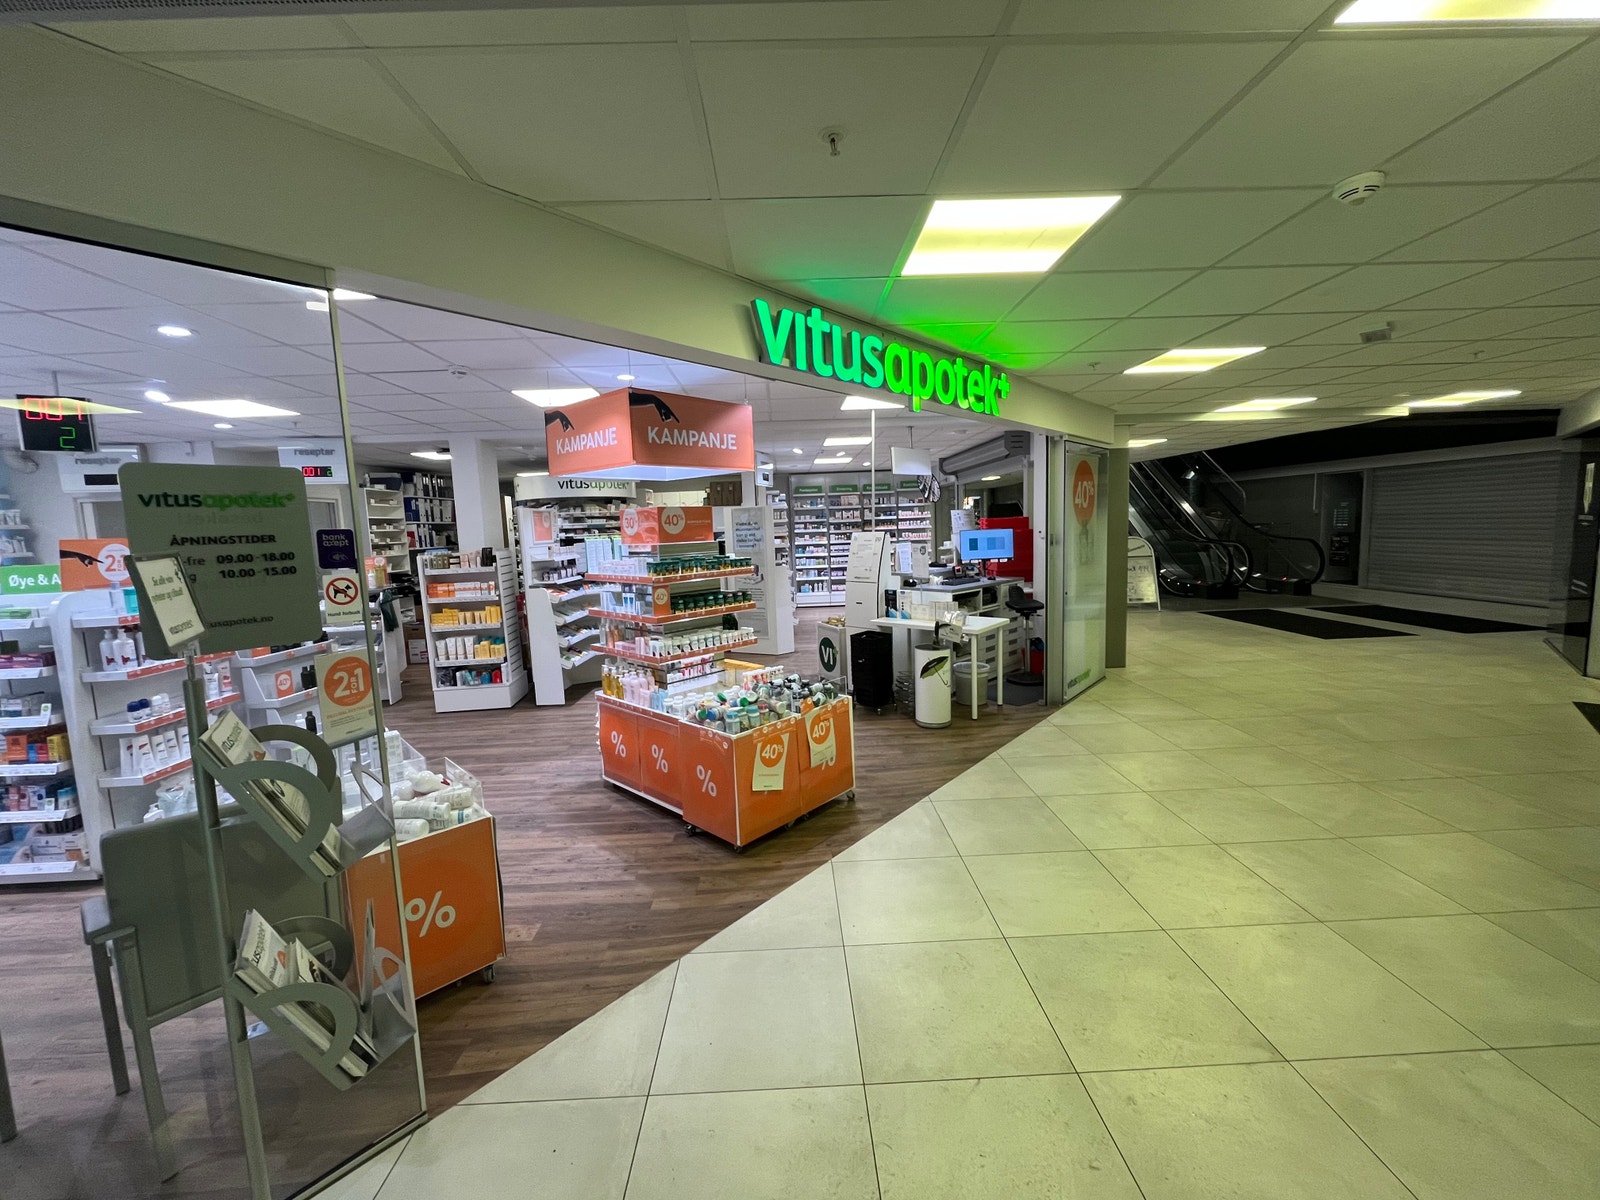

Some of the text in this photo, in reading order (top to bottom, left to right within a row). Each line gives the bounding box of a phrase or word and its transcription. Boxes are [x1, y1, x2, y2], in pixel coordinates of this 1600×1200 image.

[60, 427, 75, 448] 2
[556, 427, 618, 455] KAMPANJE
[647, 426, 737, 450] KAMPANJE
[1074, 482, 1094, 508] 40%
[664, 514, 684, 526] 40%
[170, 534, 276, 547] ÅPNINGSTIDER
[322, 533, 346, 541] bank
[216, 553, 254, 565] 09.00
[261, 552, 295, 562] 18.00
[8, 574, 35, 589] Øye
[37, 573, 49, 585] &
[219, 568, 256, 579] 10.00
[263, 565, 297, 576] 15.00
[209, 615, 274, 628] usapotek.no
[333, 671, 351, 698] 2
[354, 667, 364, 692] 1
[812, 721, 829, 738] 40%
[610, 730, 627, 758] %
[761, 744, 783, 759] 40%
[651, 744, 669, 774] %
[696, 764, 717, 797] %
[405, 890, 456, 938] %
